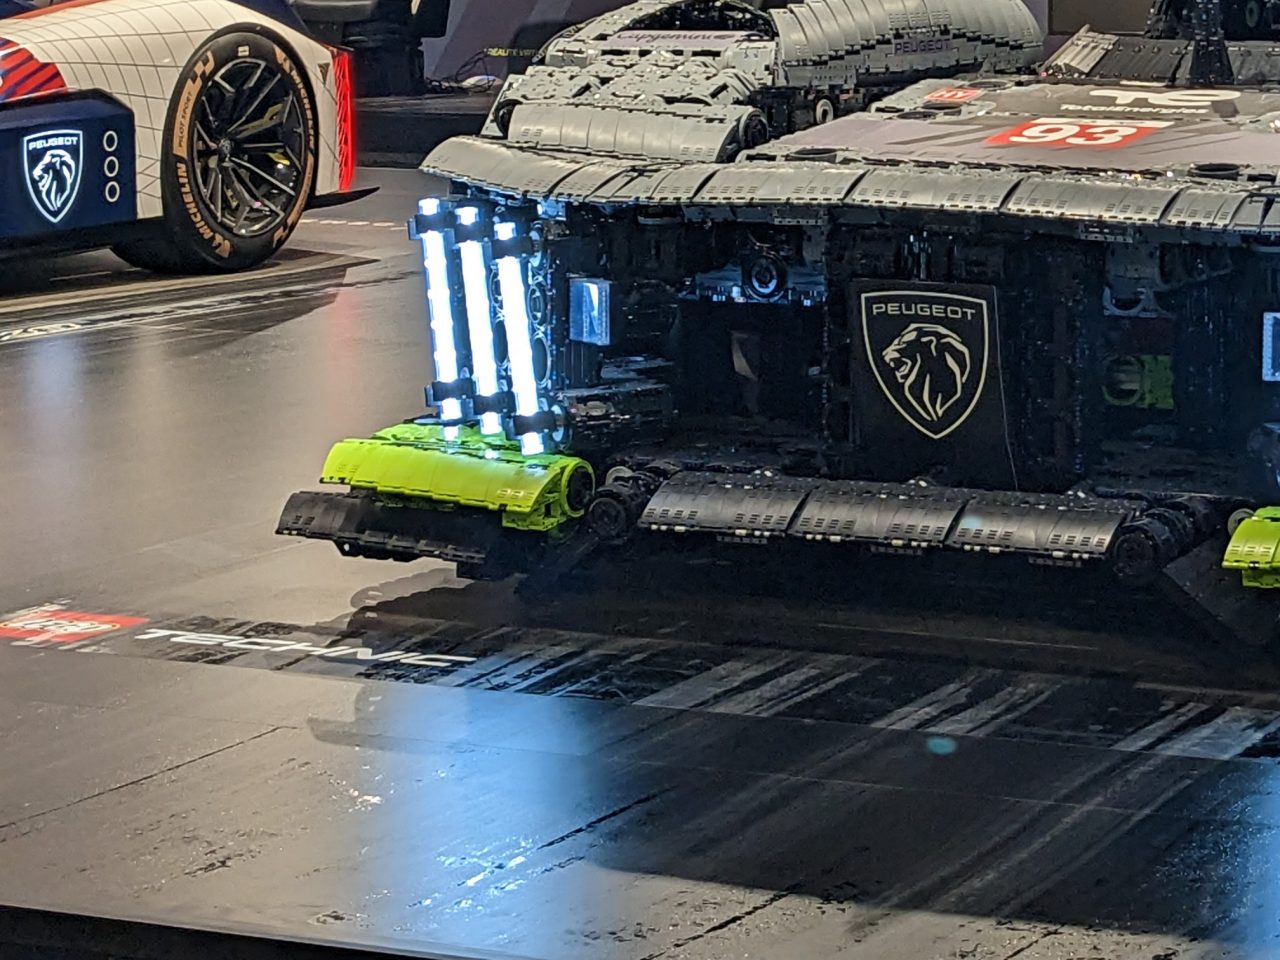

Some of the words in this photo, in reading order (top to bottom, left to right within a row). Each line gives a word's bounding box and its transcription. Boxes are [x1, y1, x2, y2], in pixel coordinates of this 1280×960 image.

[1060, 103, 1210, 114] TotalEnergies
[29, 136, 79, 151] PEUGEOT
[1009, 124, 1138, 146] 93
[176, 162, 214, 240] MICHELIN
[872, 303, 976, 321] PEUGEOT
[134, 629, 478, 667] TECHNIC
